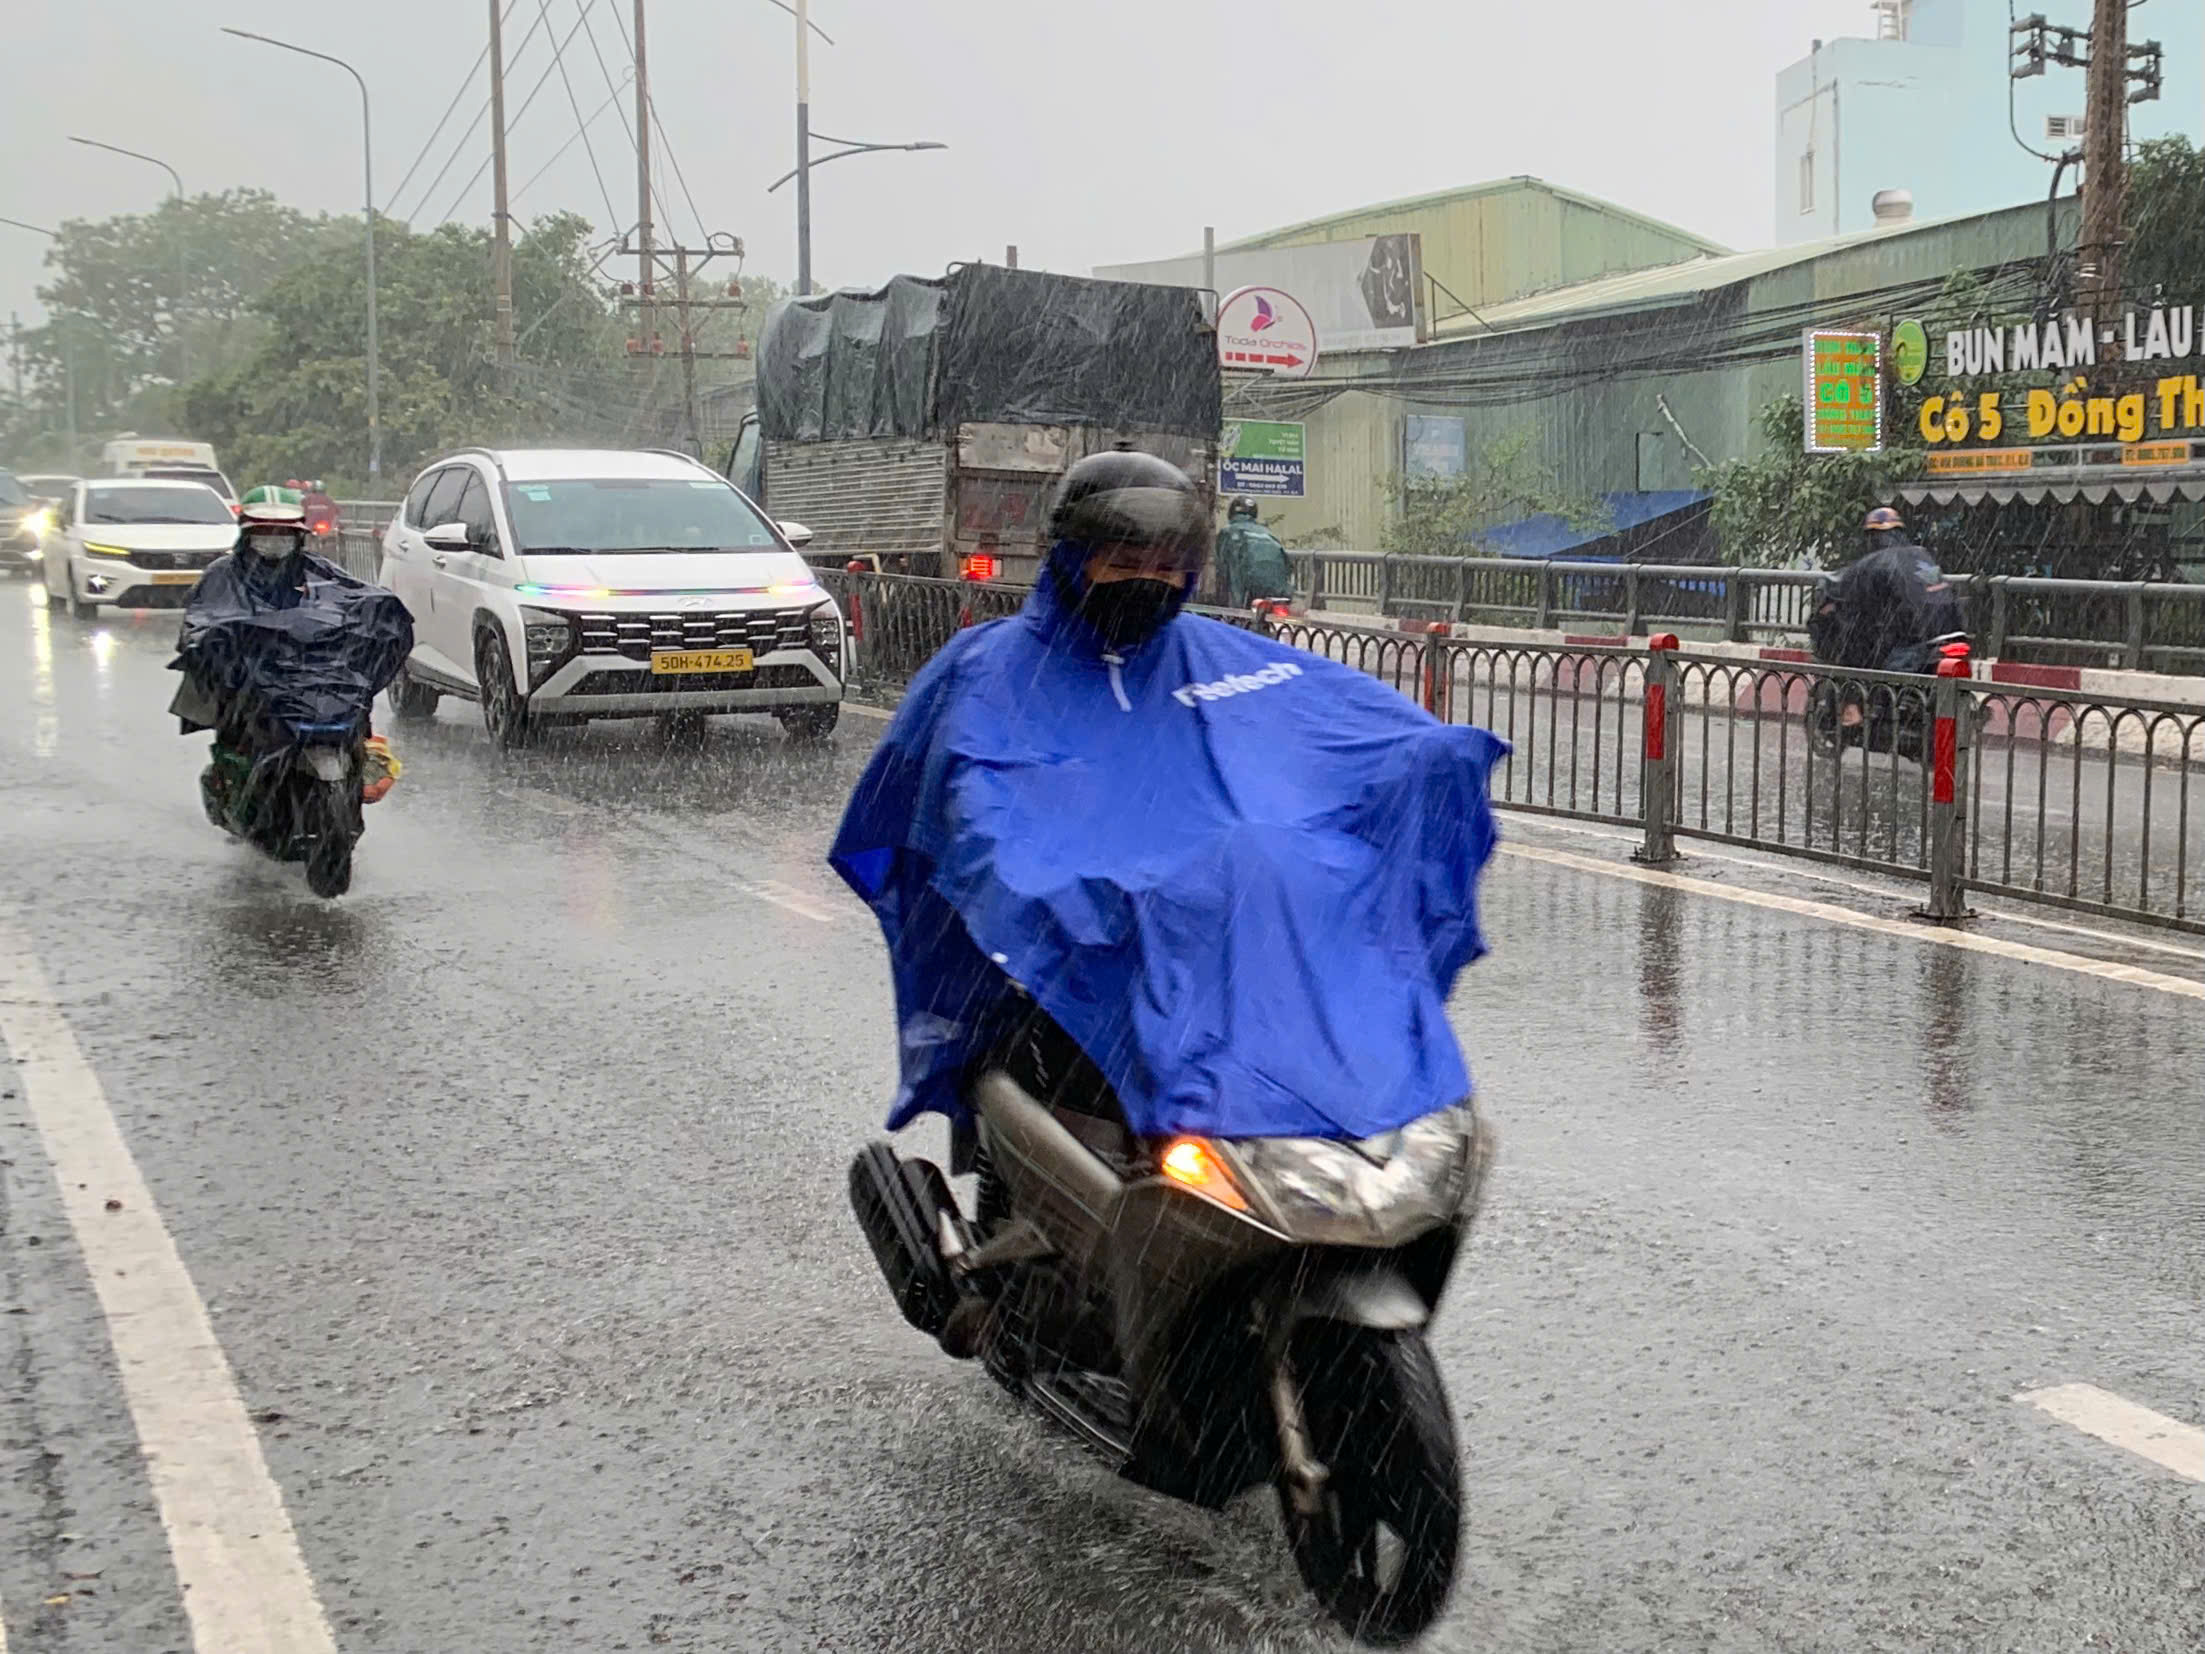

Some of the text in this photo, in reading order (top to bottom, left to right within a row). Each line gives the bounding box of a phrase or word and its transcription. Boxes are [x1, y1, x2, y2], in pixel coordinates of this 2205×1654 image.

[1919, 390, 1970, 443] Cô
[1978, 392, 2002, 440] 5
[1241, 462, 1264, 473] MAI
